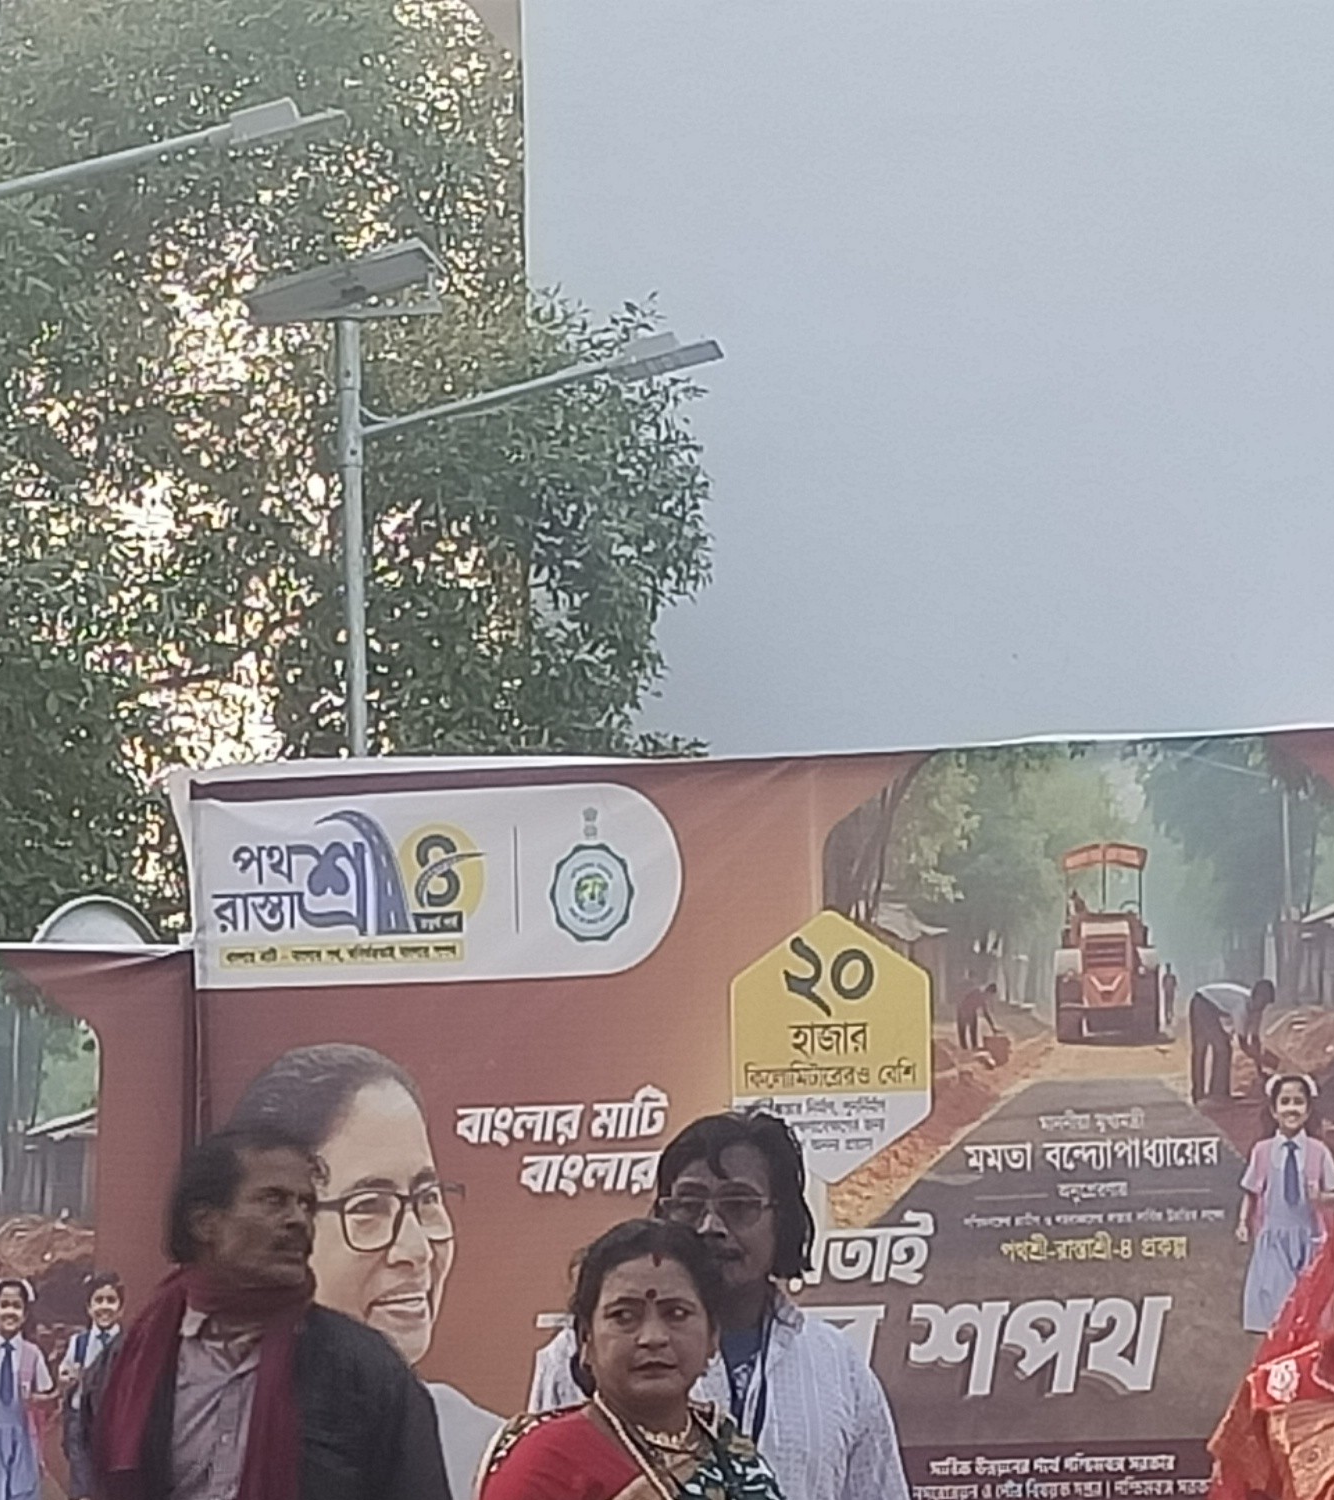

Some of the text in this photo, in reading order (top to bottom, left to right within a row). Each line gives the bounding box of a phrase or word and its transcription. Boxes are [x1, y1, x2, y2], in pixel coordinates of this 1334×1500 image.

[232, 844, 293, 885] পথ
[211, 891, 304, 933] রাস্তা
[783, 936, 875, 1018] ২০
[789, 1021, 869, 1060] হাজার
[877, 1056, 917, 1086] বেশি
[456, 1104, 584, 1147] বাংলার
[591, 1084, 668, 1139] মাটি
[520, 1151, 663, 1196] বাংলার
[965, 1135, 1220, 1172] মমতা বন্দ্যোপাধ্যায়ের
[907, 1295, 1172, 1397] শপথ
